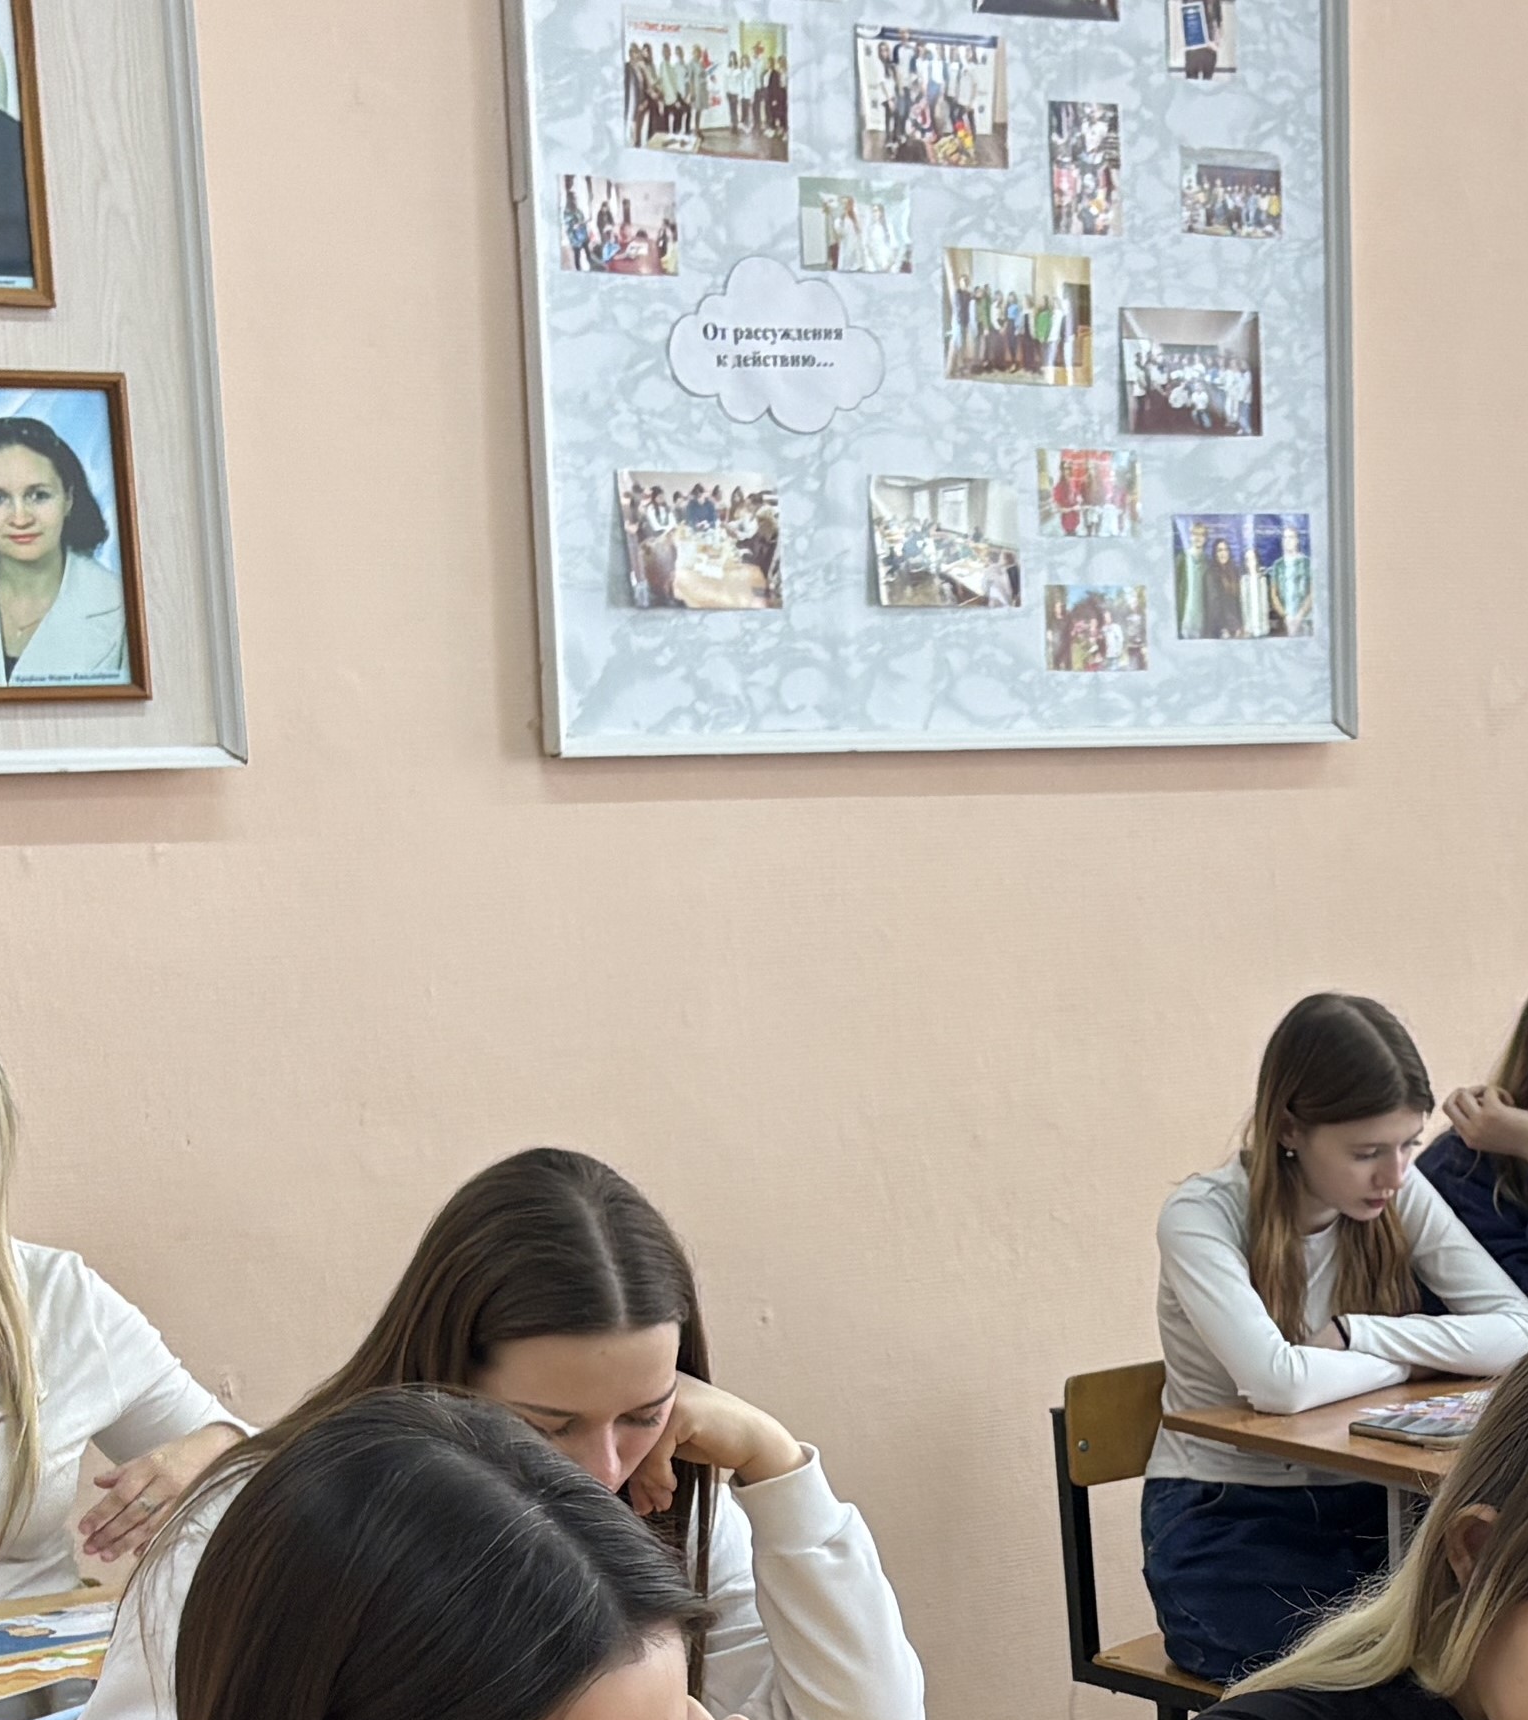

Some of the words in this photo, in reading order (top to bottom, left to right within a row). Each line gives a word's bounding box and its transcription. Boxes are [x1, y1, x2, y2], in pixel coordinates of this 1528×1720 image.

[702, 322, 727, 341] От
[733, 327, 843, 345] рассуждения
[716, 354, 728, 368] к
[731, 351, 834, 369] действию...
